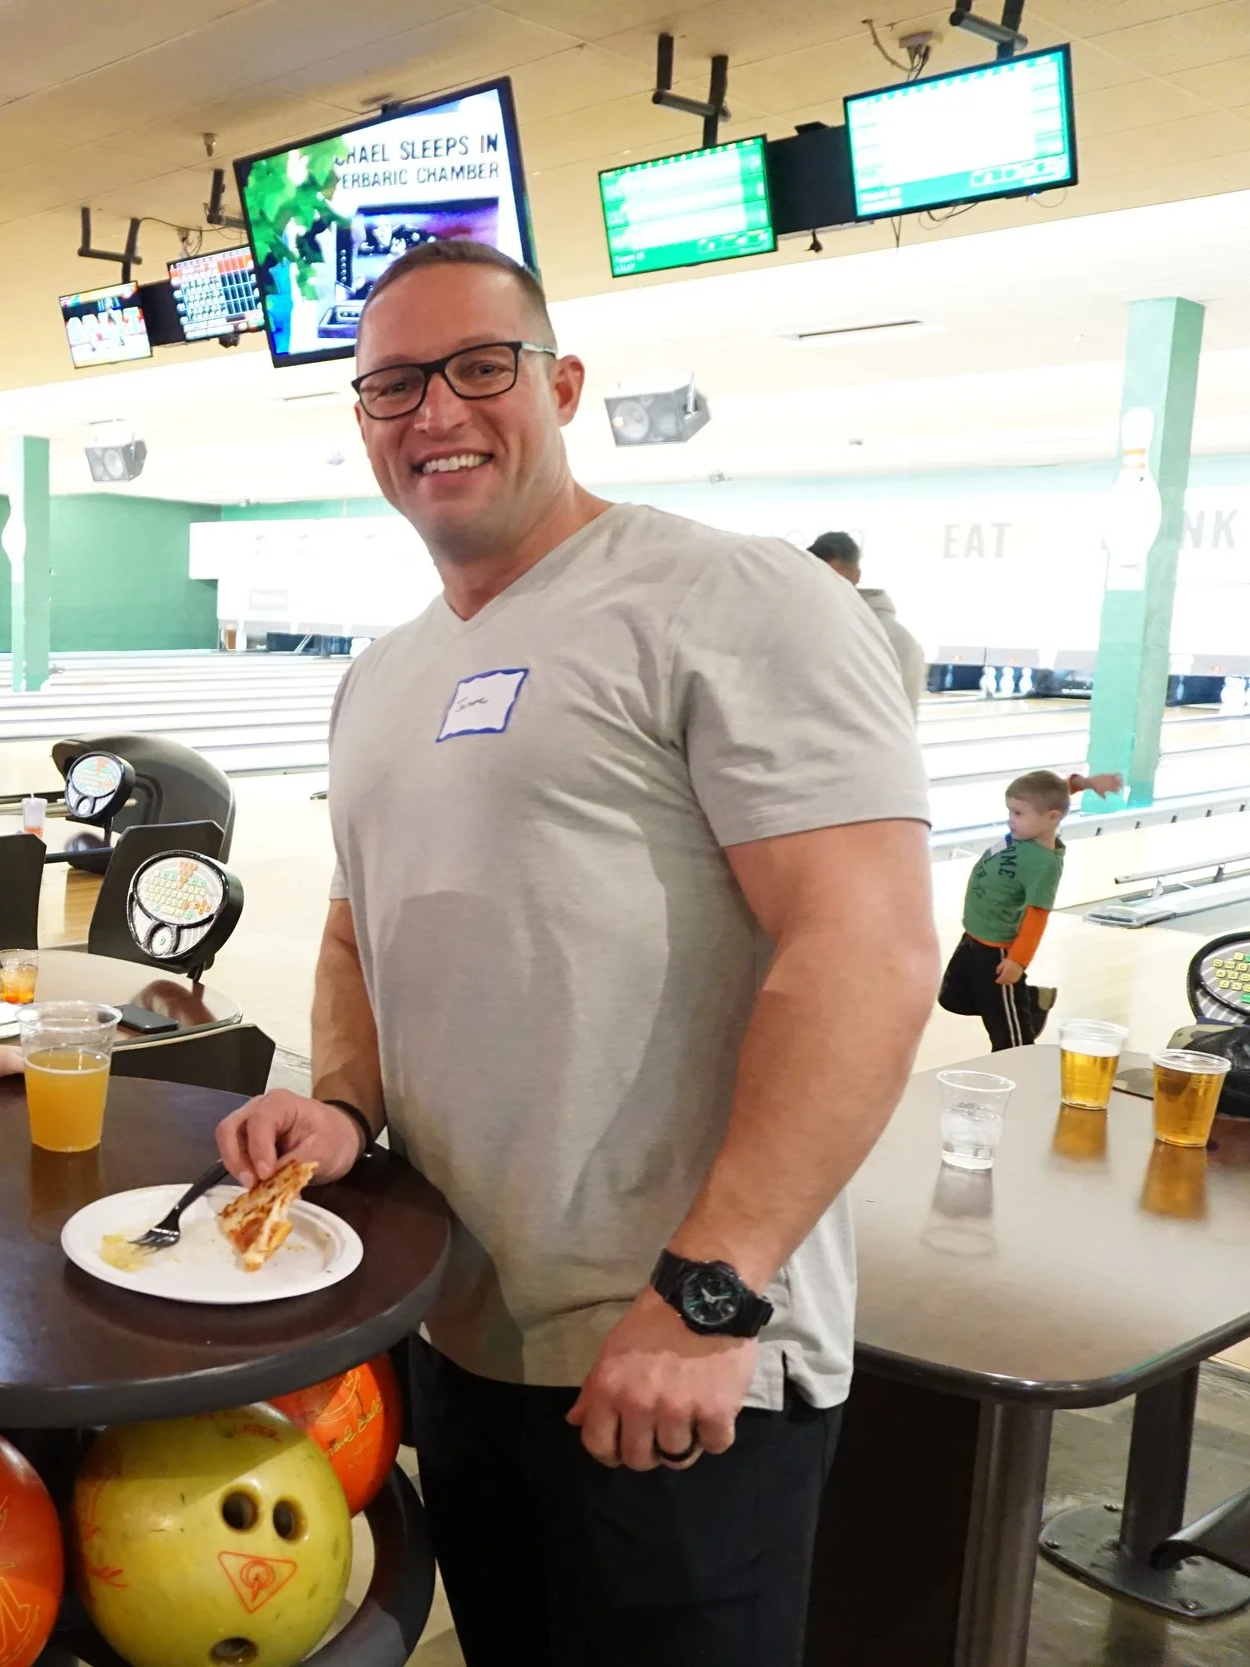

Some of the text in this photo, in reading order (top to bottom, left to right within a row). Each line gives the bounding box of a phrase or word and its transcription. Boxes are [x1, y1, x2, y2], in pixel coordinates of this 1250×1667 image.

[334, 133, 499, 166] HAEL SLEEPS IN
[340, 161, 499, 190] ERBARIC CHAMBER
[943, 521, 1013, 560] EAT
